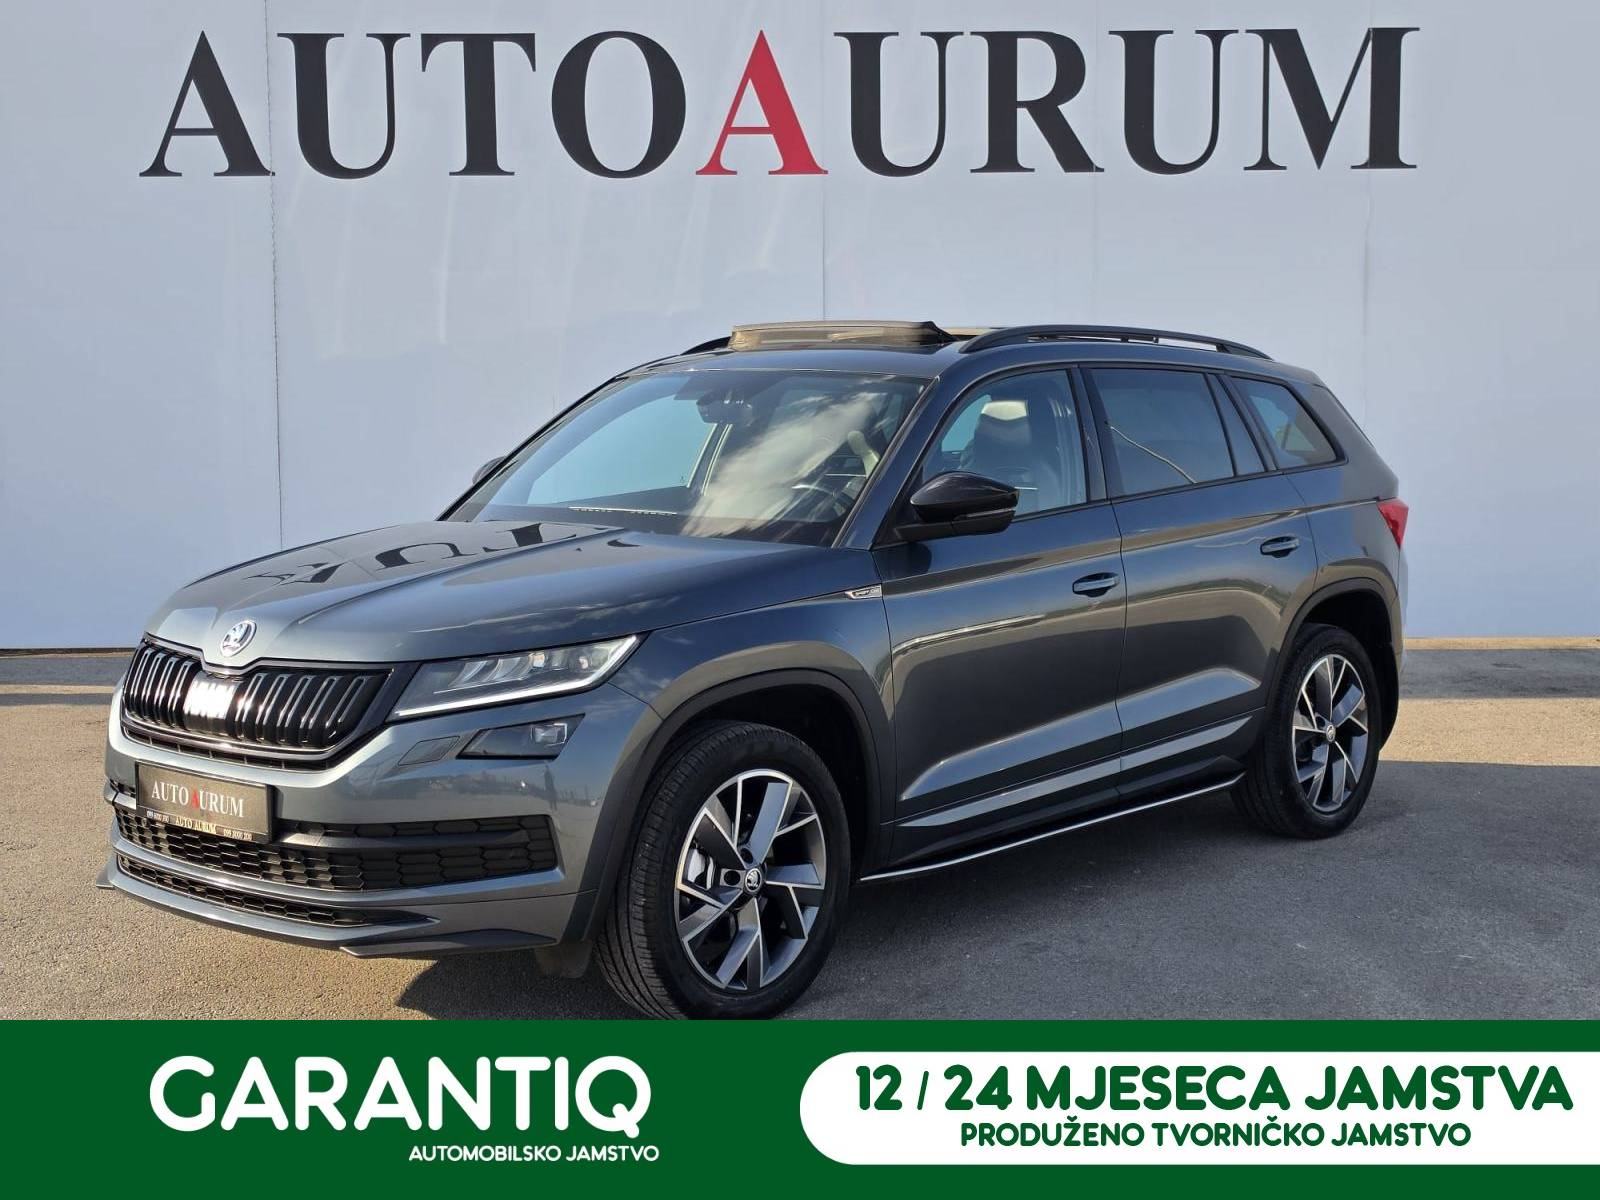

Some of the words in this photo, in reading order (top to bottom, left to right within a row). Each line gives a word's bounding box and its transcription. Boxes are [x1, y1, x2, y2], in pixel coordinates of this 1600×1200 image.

[152, 780, 189, 806] AUTO
[191, 785, 244, 818] AURUM
[175, 815, 193, 829] AUTO
